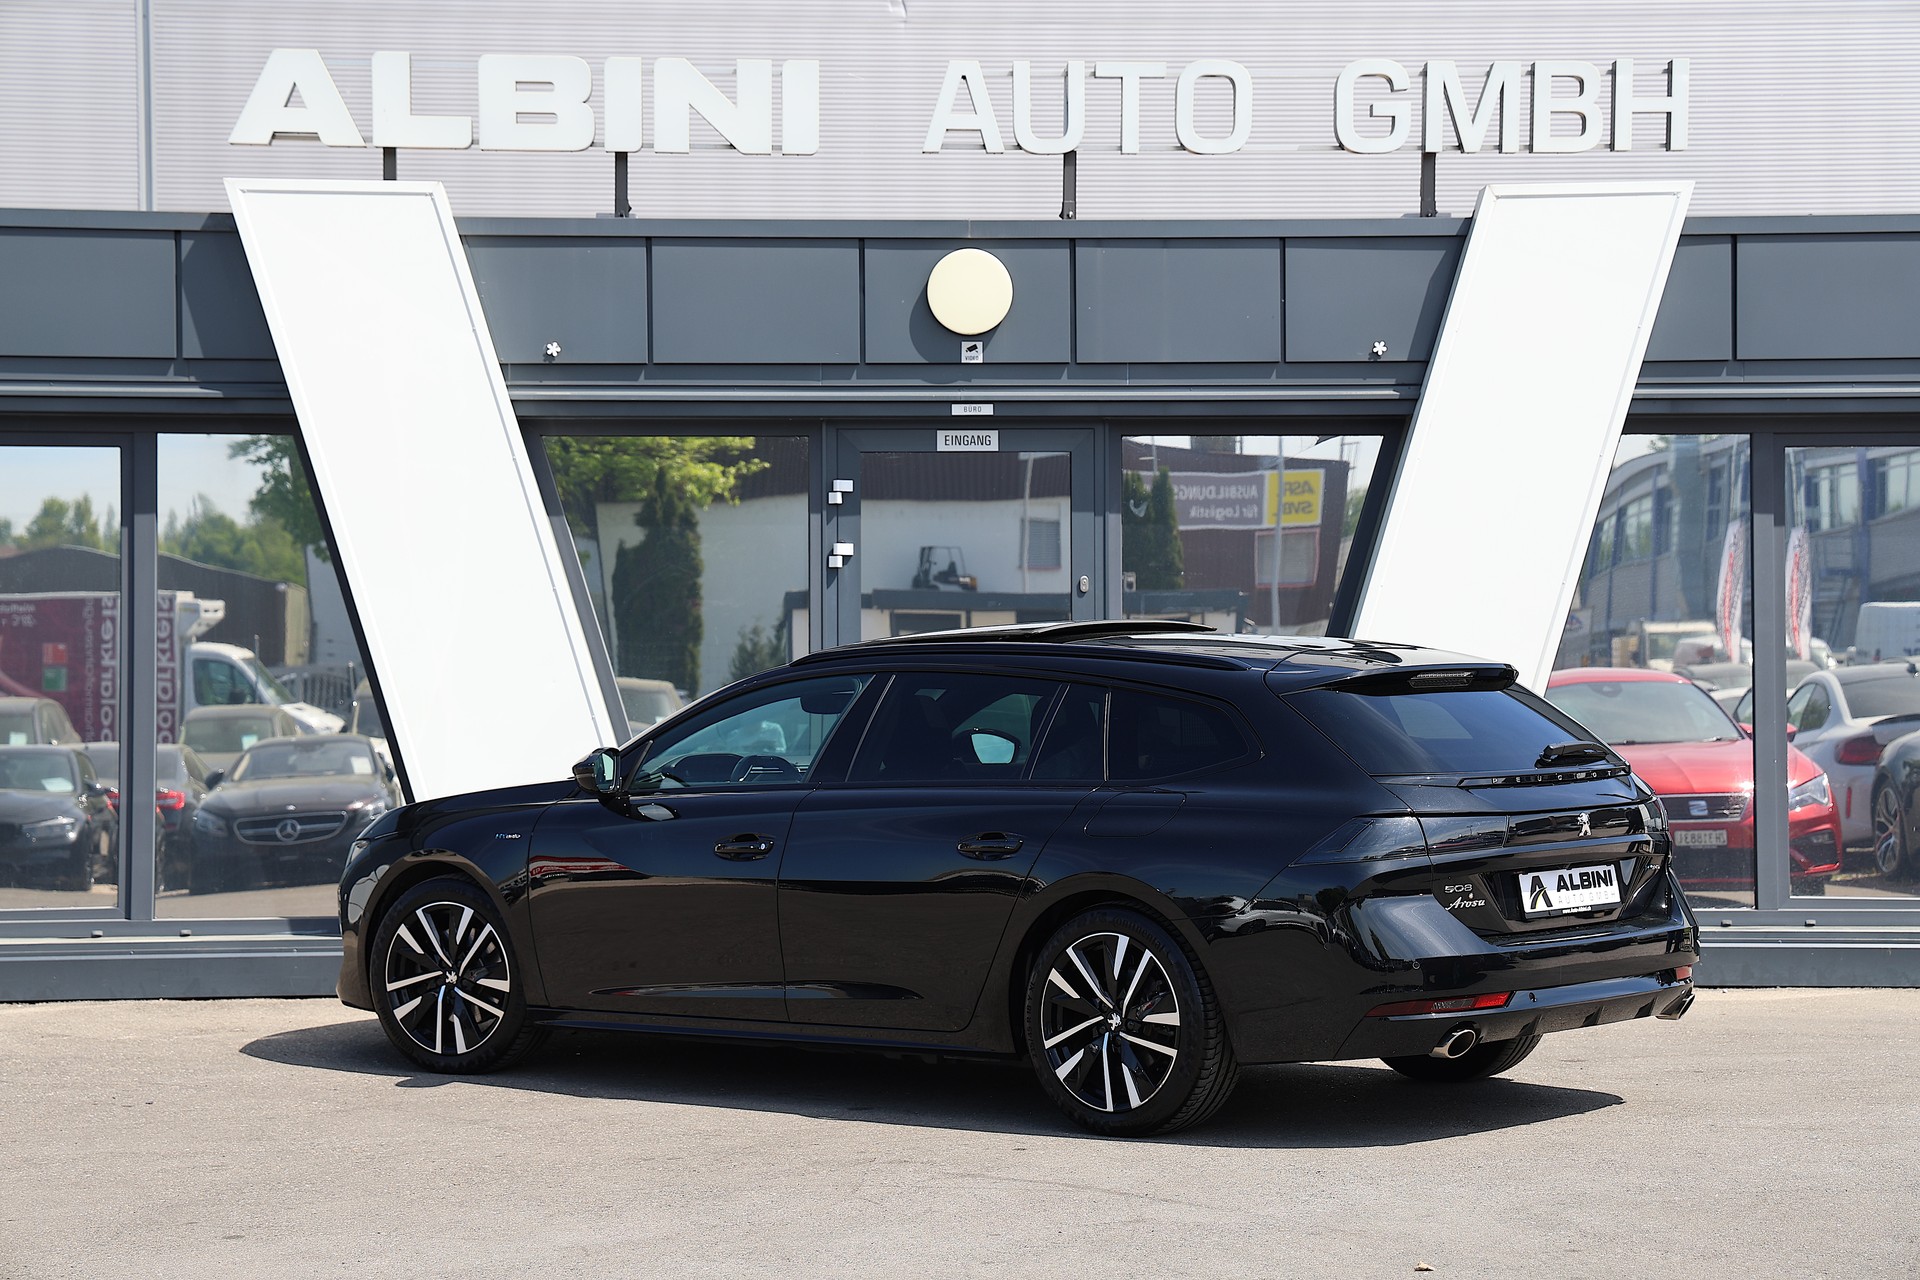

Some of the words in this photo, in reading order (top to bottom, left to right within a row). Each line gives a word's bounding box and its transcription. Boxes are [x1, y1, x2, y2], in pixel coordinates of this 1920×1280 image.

[228, 48, 820, 156] ALBINI
[922, 58, 1253, 155] AUTO
[1333, 57, 1691, 154] GMBH
[963, 404, 982, 413] BÜRO
[944, 434, 992, 446] EINGANG
[1556, 869, 1613, 892] ALBINI
[1444, 883, 1473, 894] 508
[1445, 895, 1486, 911] Arosa
[1558, 893, 1585, 904] AUTO
